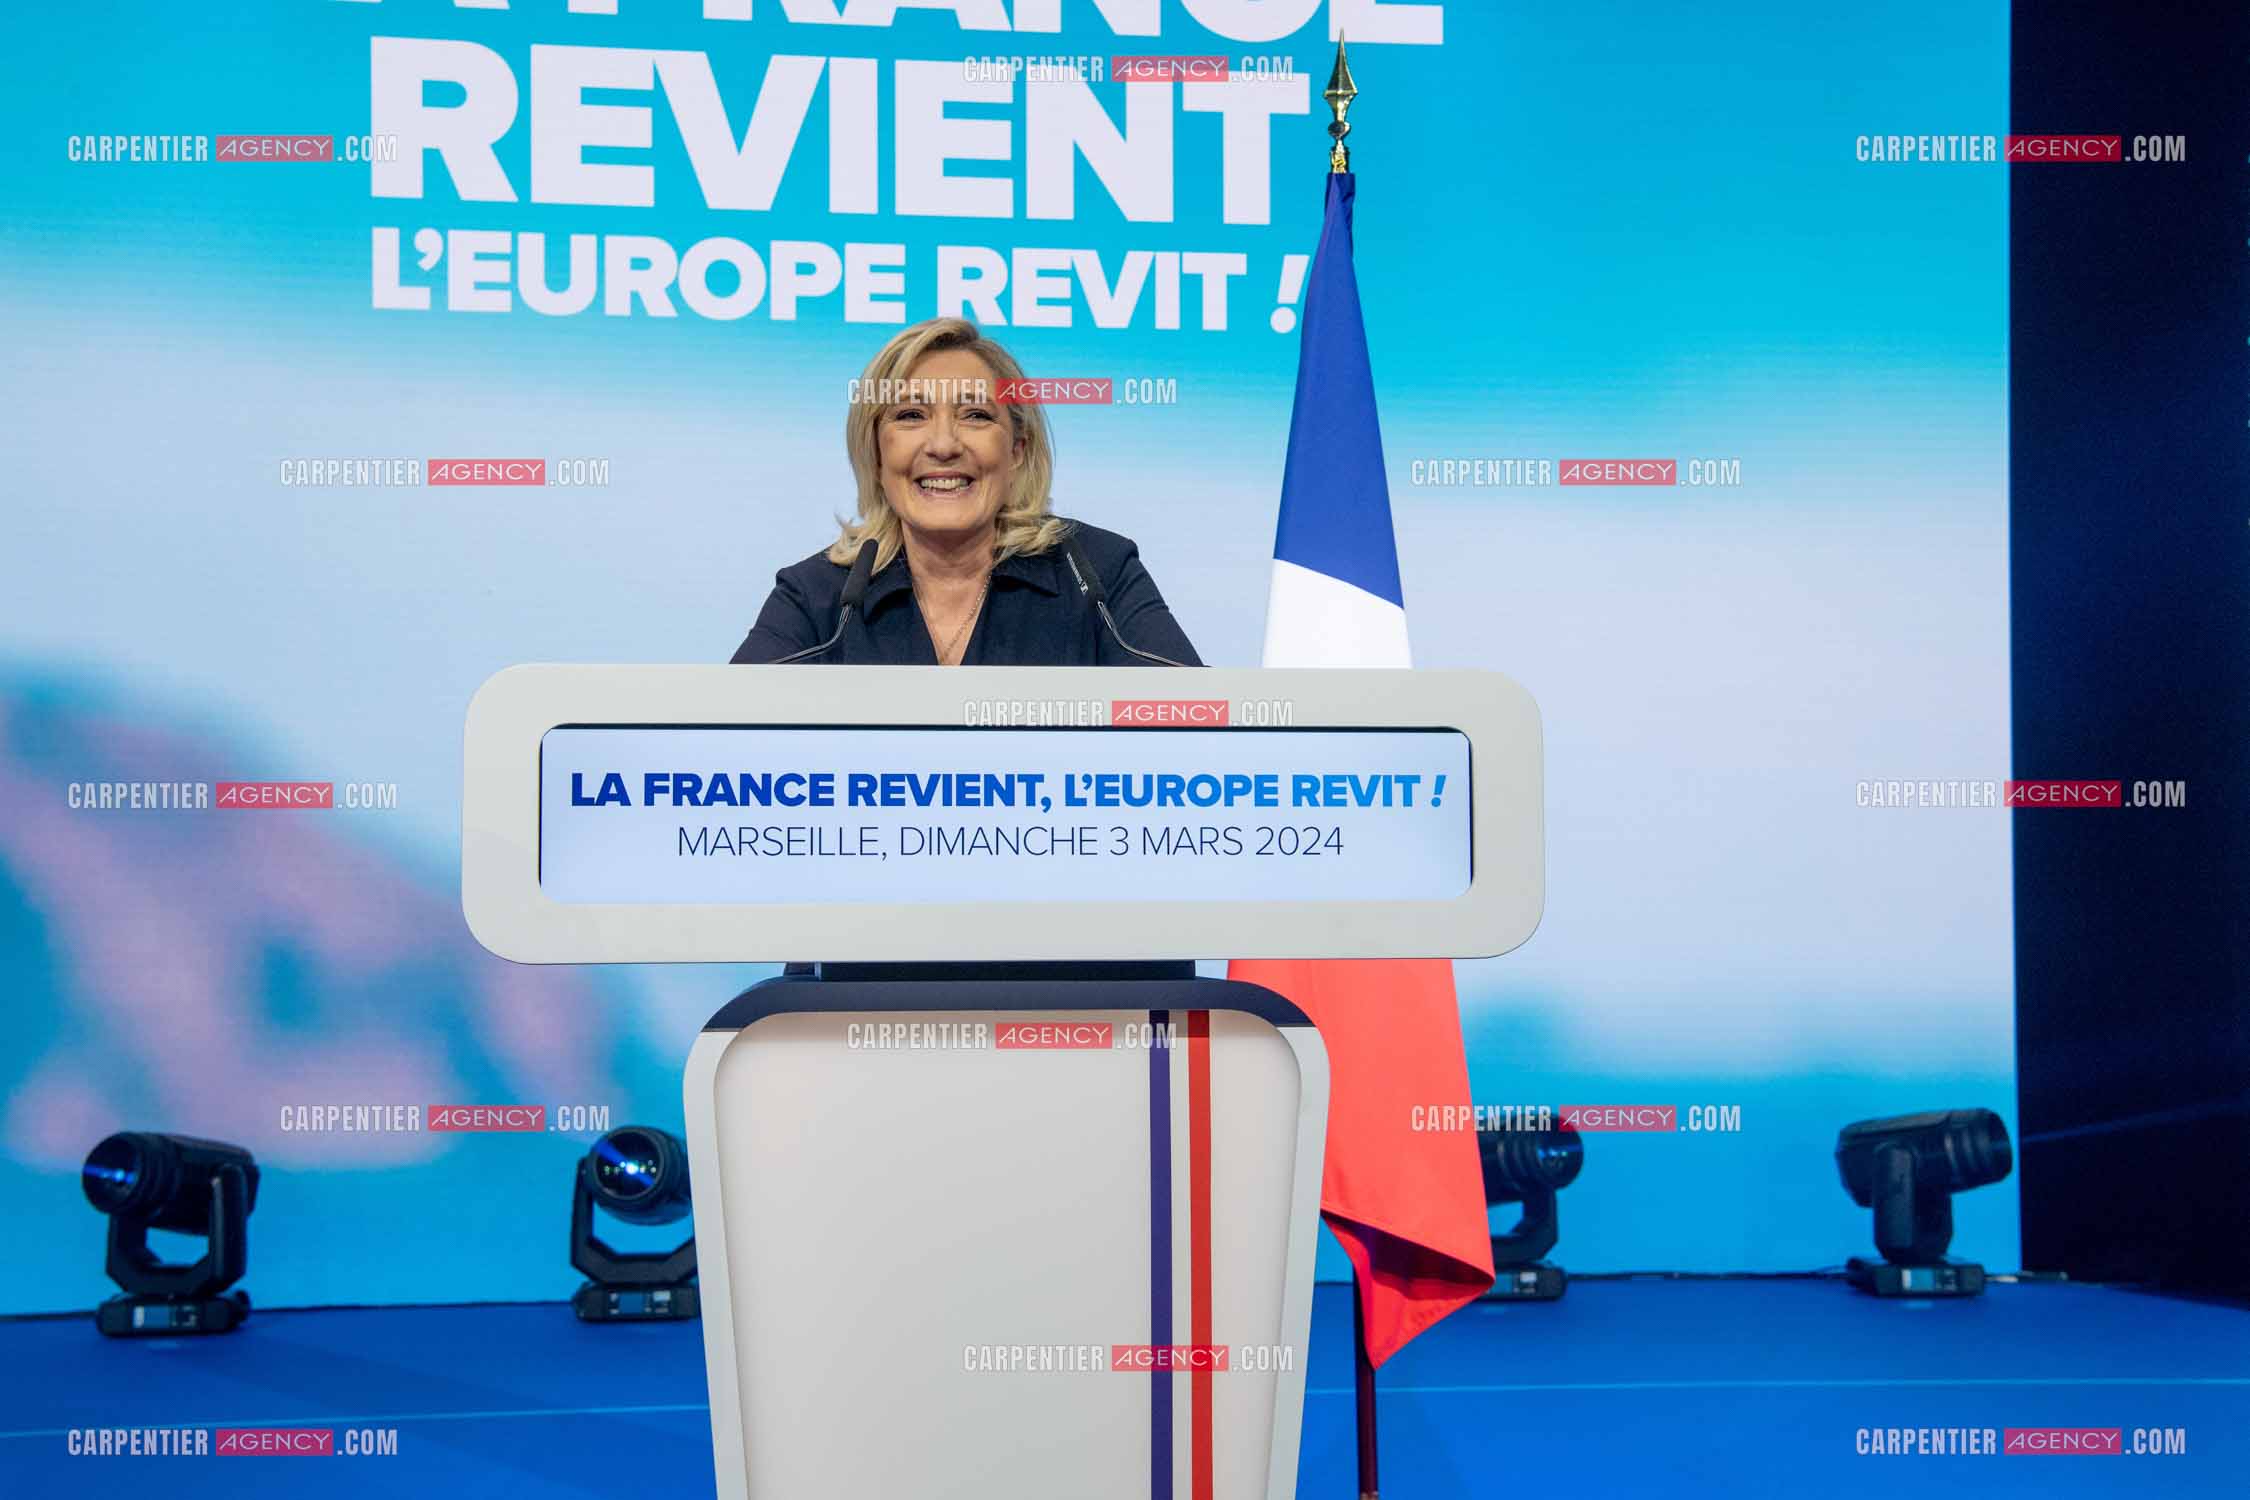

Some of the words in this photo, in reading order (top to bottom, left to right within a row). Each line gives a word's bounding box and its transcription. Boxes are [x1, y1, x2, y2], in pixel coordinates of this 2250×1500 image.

[370, 36, 1310, 224] REVIENT
[371, 227, 906, 325] L’EUROPE
[937, 245, 1248, 331] REVIT
[1270, 254, 1309, 333] !
[571, 772, 632, 807] LA
[643, 772, 835, 808] FRANCE
[847, 773, 1052, 814] REVIENT,
[1064, 773, 1280, 808] L’EUROPE
[1291, 774, 1422, 808] REVIT
[1430, 774, 1447, 808] !
[678, 826, 887, 861] MARSEILLE,
[900, 826, 1098, 856] DIMANCHE
[1109, 826, 1129, 856] 3
[1142, 826, 1243, 856] MARS
[1255, 826, 1344, 856] 2024
